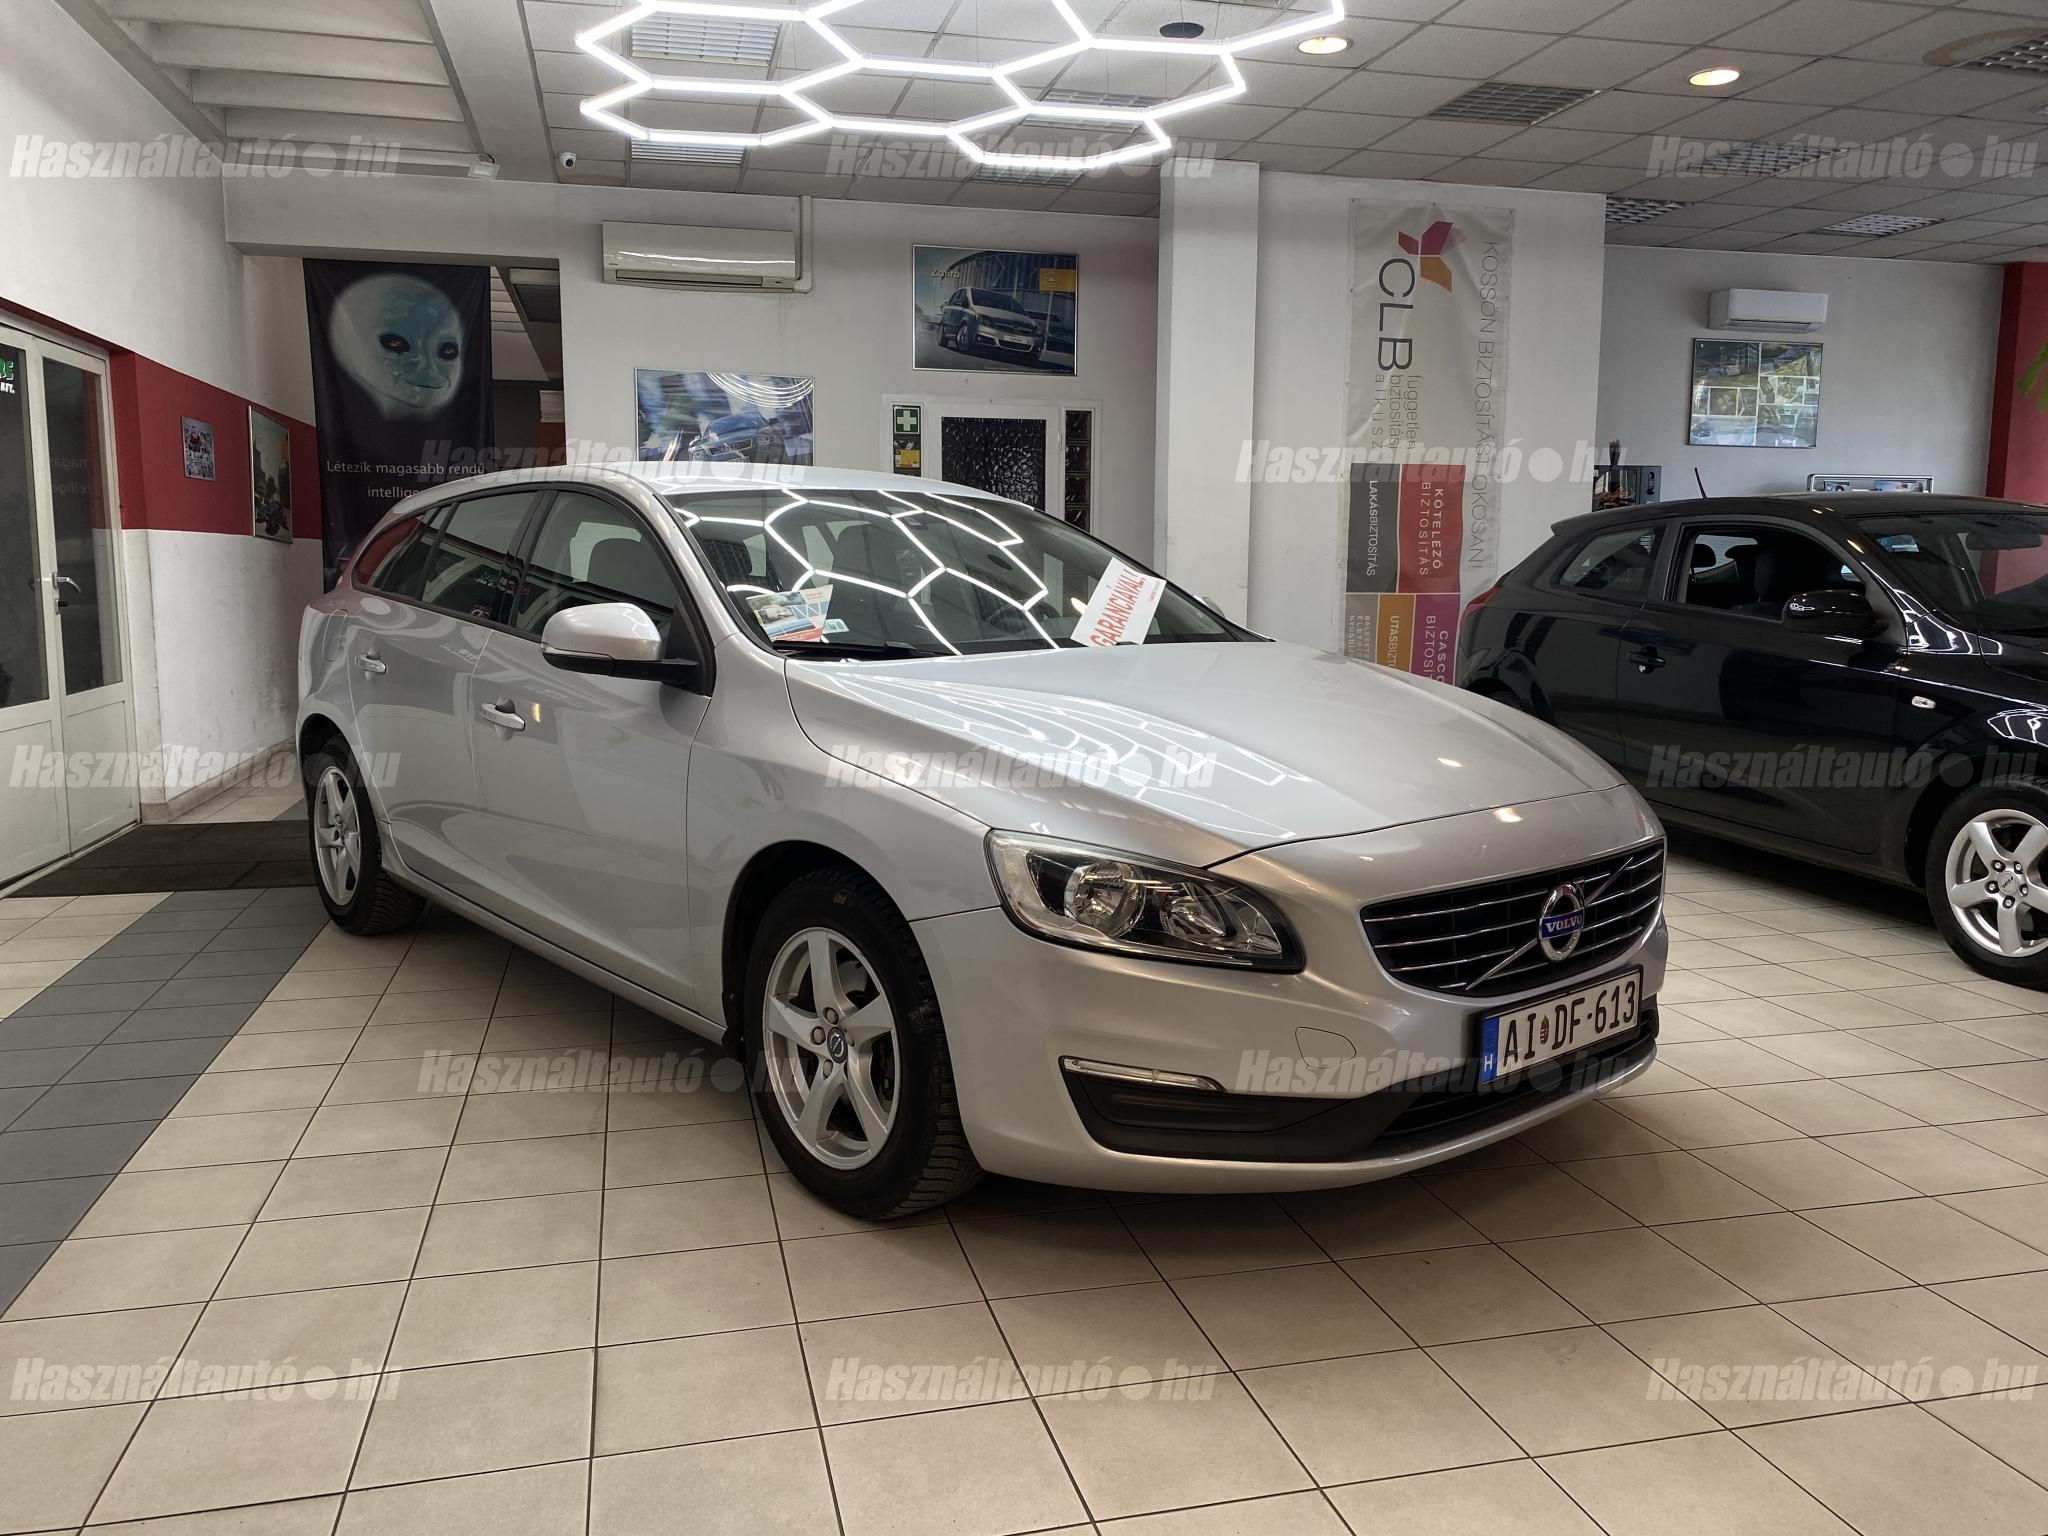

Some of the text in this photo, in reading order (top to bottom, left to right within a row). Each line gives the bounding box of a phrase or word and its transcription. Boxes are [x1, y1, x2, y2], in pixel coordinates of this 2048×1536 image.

[1377, 257, 1416, 371] CLB
[327, 461, 371, 473] Létezik
[375, 463, 445, 477] magasabb
[1366, 480, 1380, 576] LAKÁSBIZTOSÍTÁS
[1418, 481, 1432, 575] BIZTOSÍTÁS
[1431, 488, 1444, 569] KÖTELEZŐ
[1468, 474, 1489, 569] OKOSAN!
[1545, 914, 1583, 933] VOLVO
[1484, 1053, 1493, 1073] H
[1503, 981, 1636, 1067] AI DF-613
